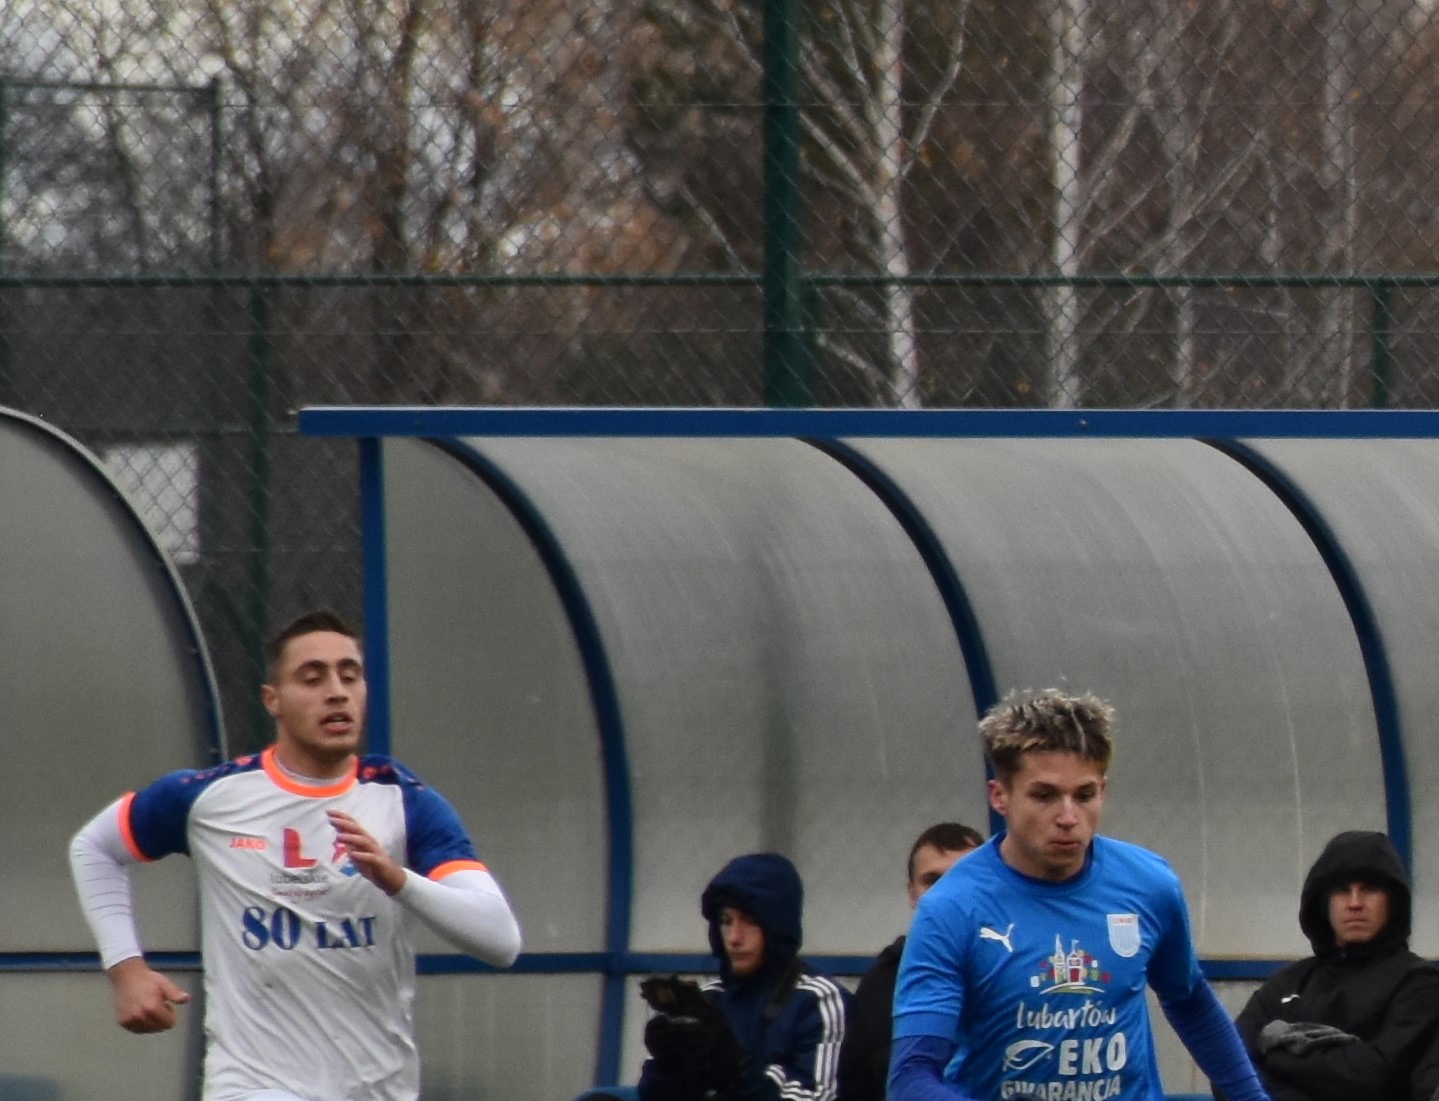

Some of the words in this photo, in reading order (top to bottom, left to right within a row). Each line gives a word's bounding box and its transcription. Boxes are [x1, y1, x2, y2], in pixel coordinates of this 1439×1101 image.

[242, 906, 300, 950] 80
[314, 916, 375, 949] LAT
[1016, 1000, 1117, 1030] Lubartów
[1058, 1032, 1127, 1075] EKO
